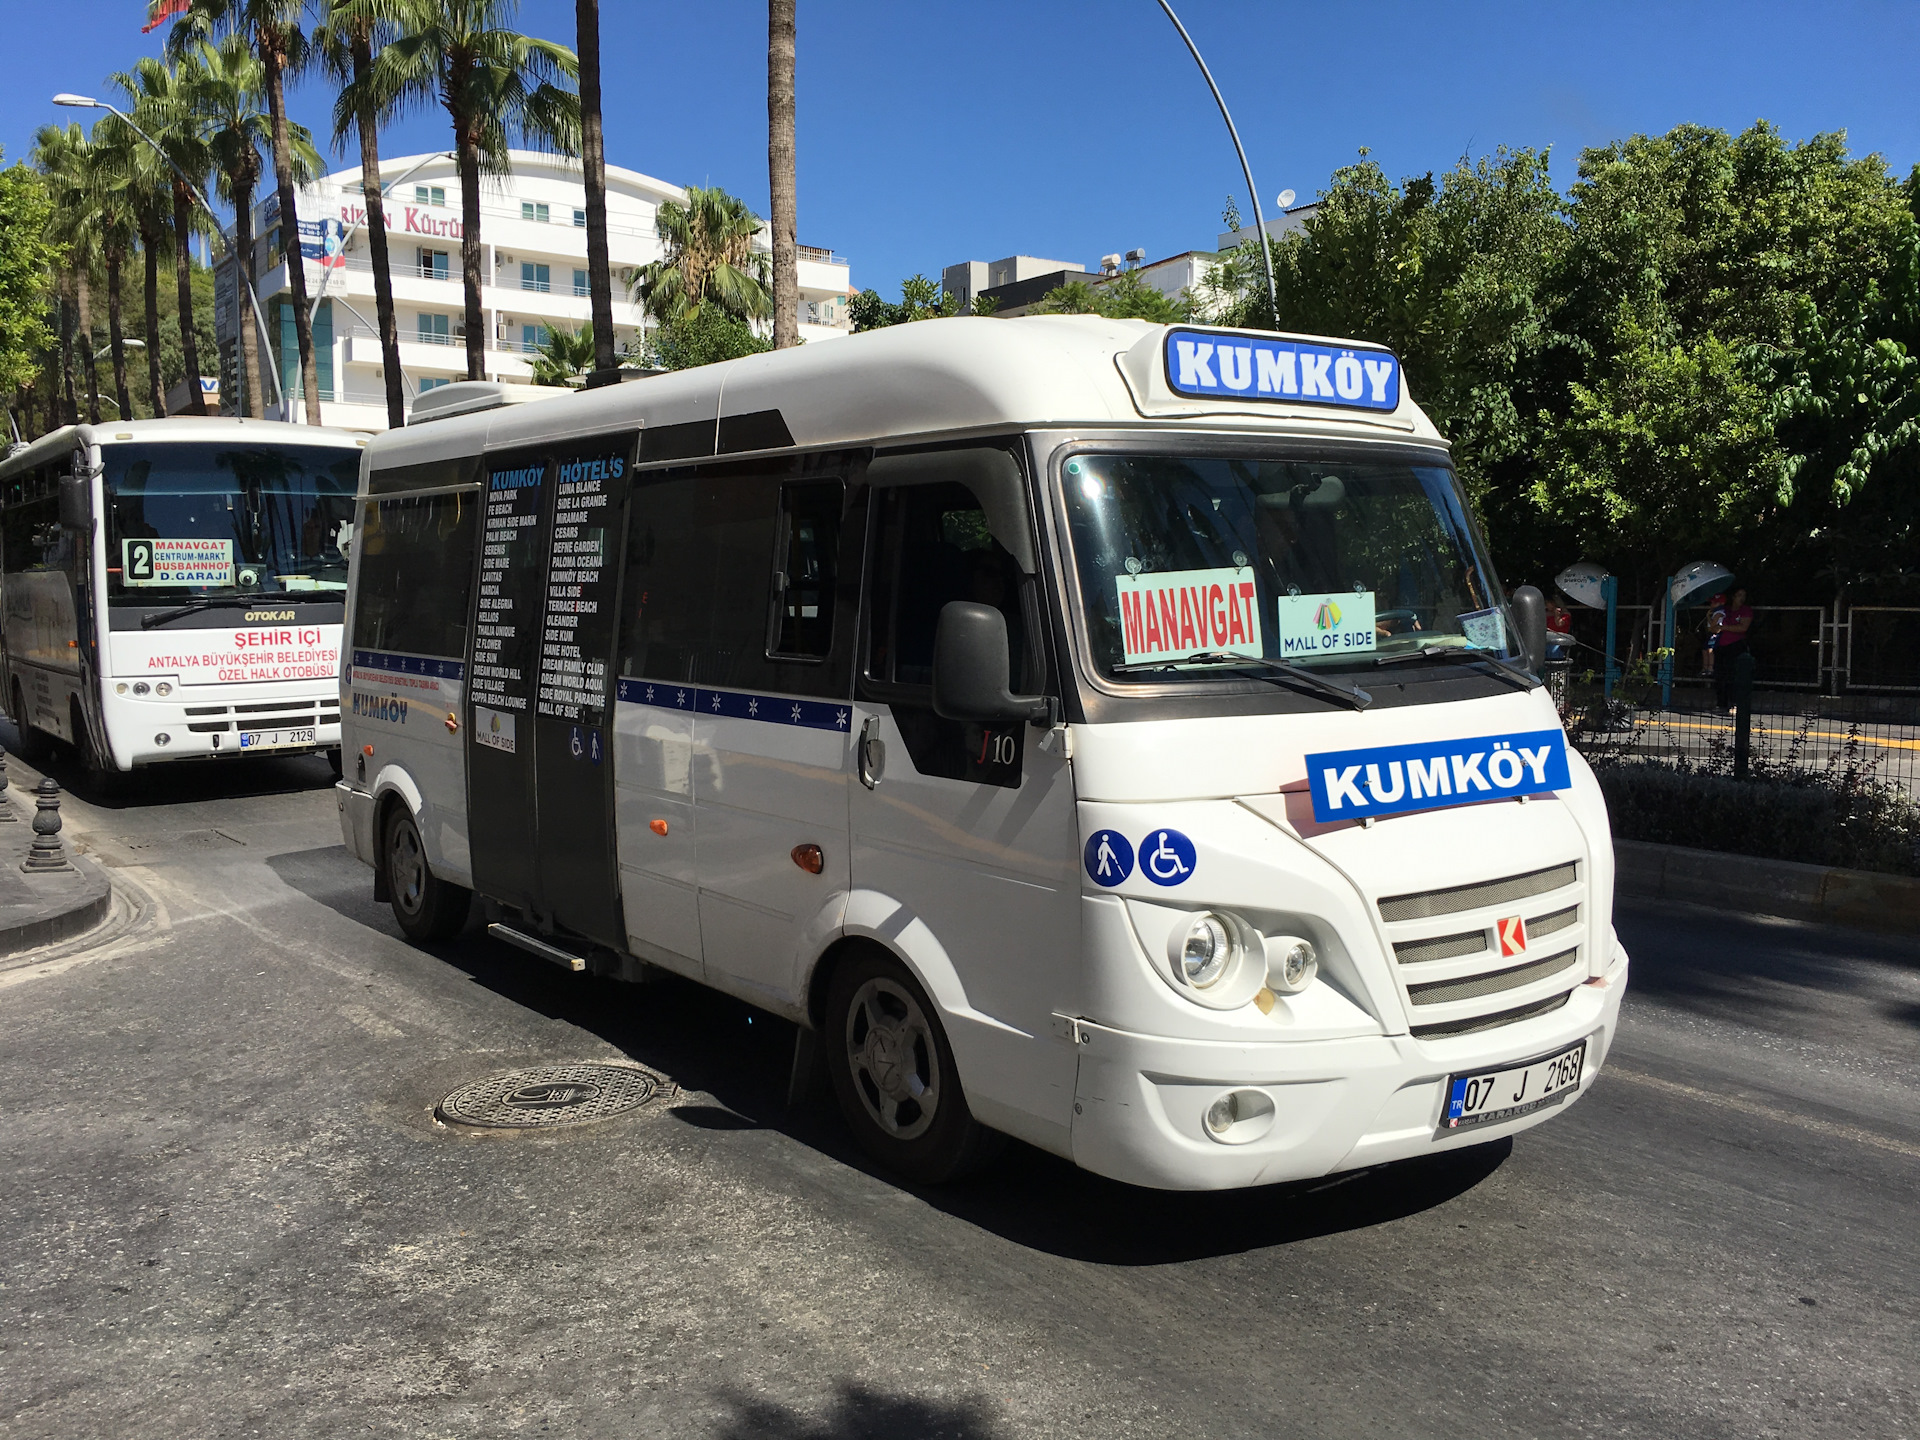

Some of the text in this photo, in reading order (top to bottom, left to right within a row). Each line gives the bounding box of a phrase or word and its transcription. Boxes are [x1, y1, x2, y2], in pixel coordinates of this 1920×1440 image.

[405, 207, 464, 239] KÜLTÜ
[1176, 340, 1393, 402] KUMKÖY
[492, 464, 545, 491] KUMKÖY
[559, 458, 624, 483] HOTEL'S
[503, 489, 518, 500] PARK
[558, 480, 601, 495] LUNA BLANCE
[495, 503, 513, 515] BEACH
[572, 496, 580, 509] LA
[581, 494, 608, 508] GRANDE
[485, 530, 518, 542] PALM BEACH
[554, 526, 579, 539] CESARS
[155, 541, 226, 550] MANAVGAT
[553, 540, 600, 553] DEFNE GARDEN
[133, 544, 150, 575] 2
[154, 552, 226, 561] CENTRUM-MARKT
[495, 557, 510, 568] MARE
[552, 555, 603, 568] PALOMA OCEANA
[154, 561, 231, 571] BUSBAHNHOF
[160, 571, 227, 580] D.GARAJI
[550, 568, 599, 582] KUMKÖY BEACH
[548, 600, 598, 613] TERRACE BEACH
[245, 610, 296, 622] OTOKAR
[546, 614, 579, 628] OLEANDER
[1120, 581, 1257, 655] MANAVGAT
[234, 627, 321, 650] ŞEHİR İÇİ
[559, 629, 574, 642] KUM
[1283, 630, 1373, 653] MALL OF SIDE
[482, 638, 502, 651] FLOWER
[543, 643, 581, 658] HANE HOTEL
[148, 646, 338, 669] ANTALYA BÜYÜKŞEHİR BELEDİYESİ
[486, 652, 498, 664] SUN
[218, 662, 334, 681] ÖZEL HALK OTOBÜSÜ
[473, 664, 491, 677] DREAM
[490, 666, 509, 679] WORLD
[542, 658, 563, 672] DREAM
[586, 662, 604, 676] CLUB
[540, 672, 603, 691] DREAM WORLD AQUA
[471, 691, 527, 709] COPPA BEACH LOUNGE
[553, 689, 573, 702] ROYAL
[573, 691, 606, 707] PARADISE
[353, 692, 408, 724] KUMKÖY
[538, 701, 554, 715] MALL
[554, 704, 564, 716] OF
[248, 734, 261, 746] 07
[272, 733, 278, 744] J
[290, 730, 313, 743] 2129
[476, 730, 514, 751] MALL OF SIDE
[1323, 740, 1552, 810] KUMKÖY
[1451, 1099, 1463, 1110] TR
[1463, 1076, 1496, 1112] 07
[1513, 1070, 1529, 1103] J
[1543, 1050, 1580, 1094] 2168
